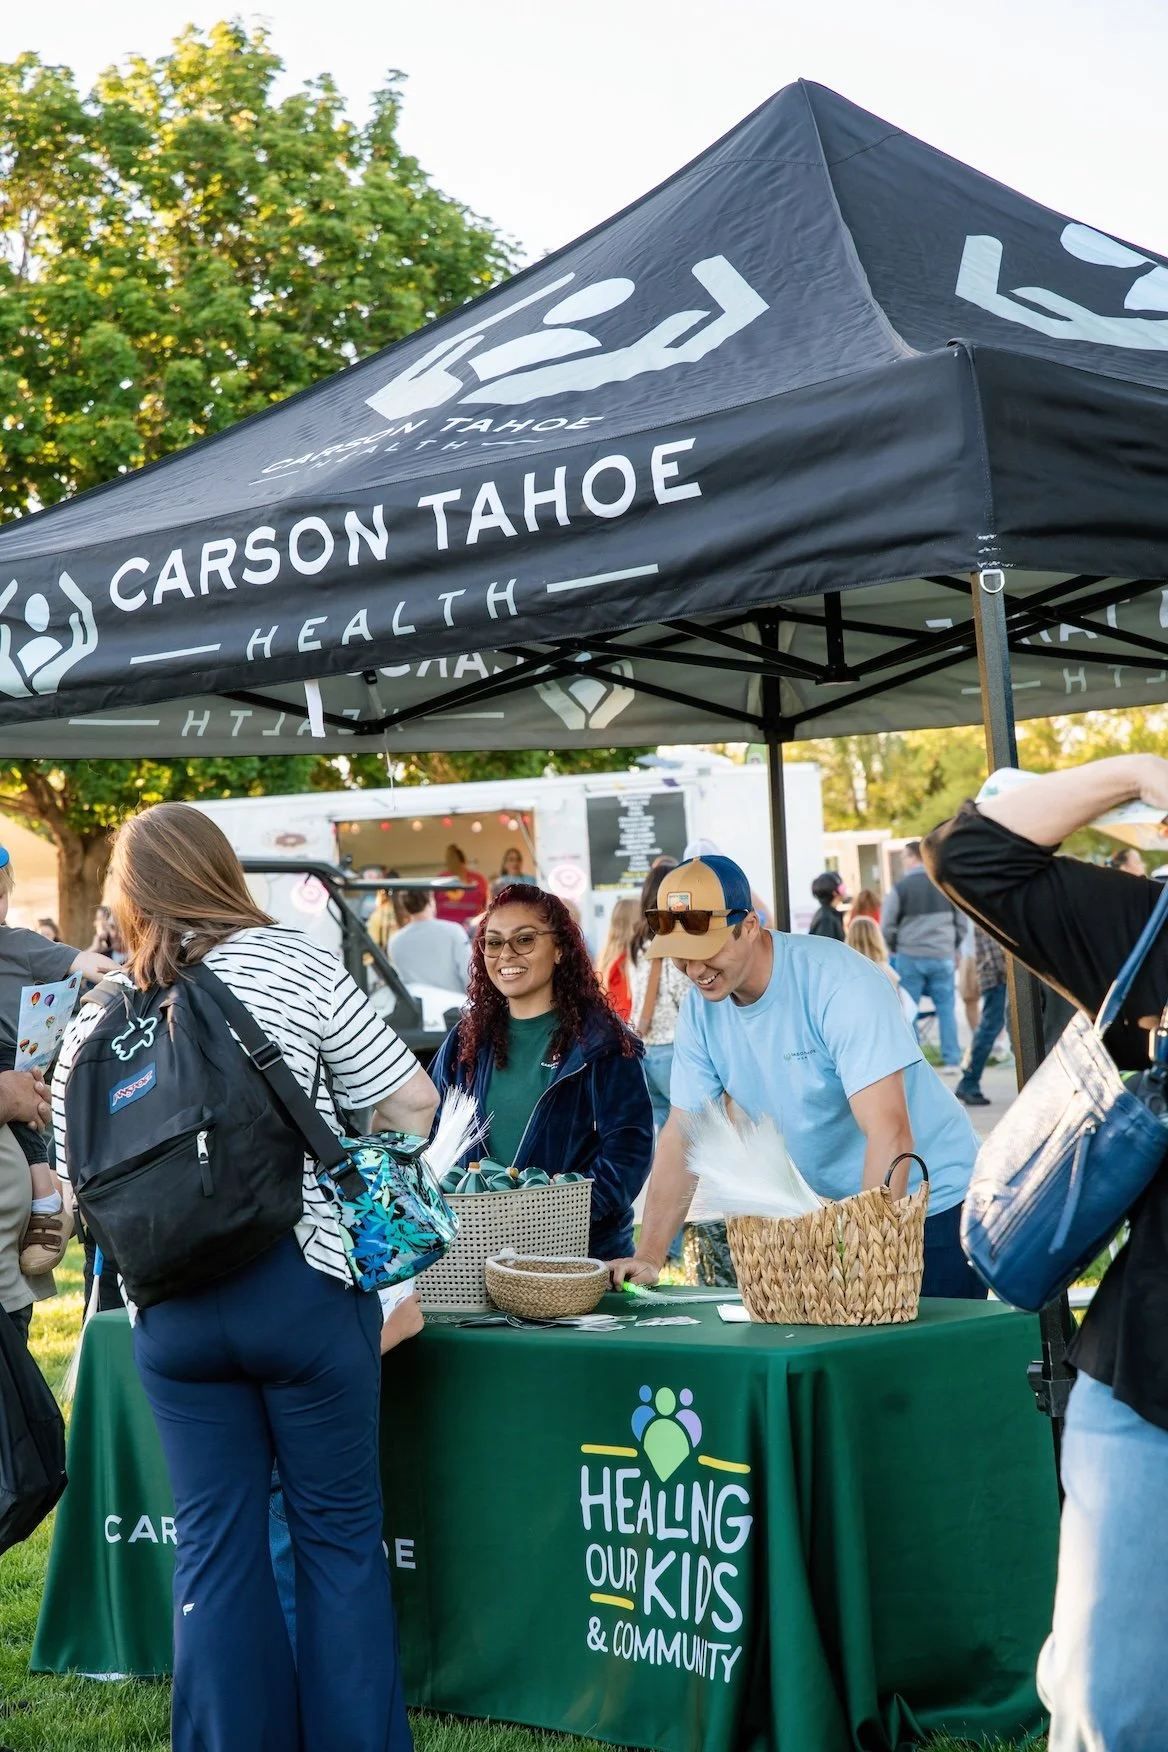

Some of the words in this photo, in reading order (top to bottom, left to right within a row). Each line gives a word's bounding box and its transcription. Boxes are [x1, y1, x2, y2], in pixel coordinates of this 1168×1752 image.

[261, 418, 428, 474] CARSON
[440, 416, 605, 434] TAHOE
[308, 440, 469, 470] HEALTH
[109, 504, 389, 614] CARSON
[417, 437, 702, 551] TAHOE
[246, 578, 519, 662] HEALTH
[112, 1069, 153, 1106] JANSPORT
[104, 1513, 179, 1545] CAR
[580, 1463, 754, 1555] HEALING
[585, 1542, 638, 1594] OUR
[643, 1546, 743, 1635] KIDS
[586, 1615, 610, 1654] &
[613, 1619, 743, 1684] COMMUNITY
